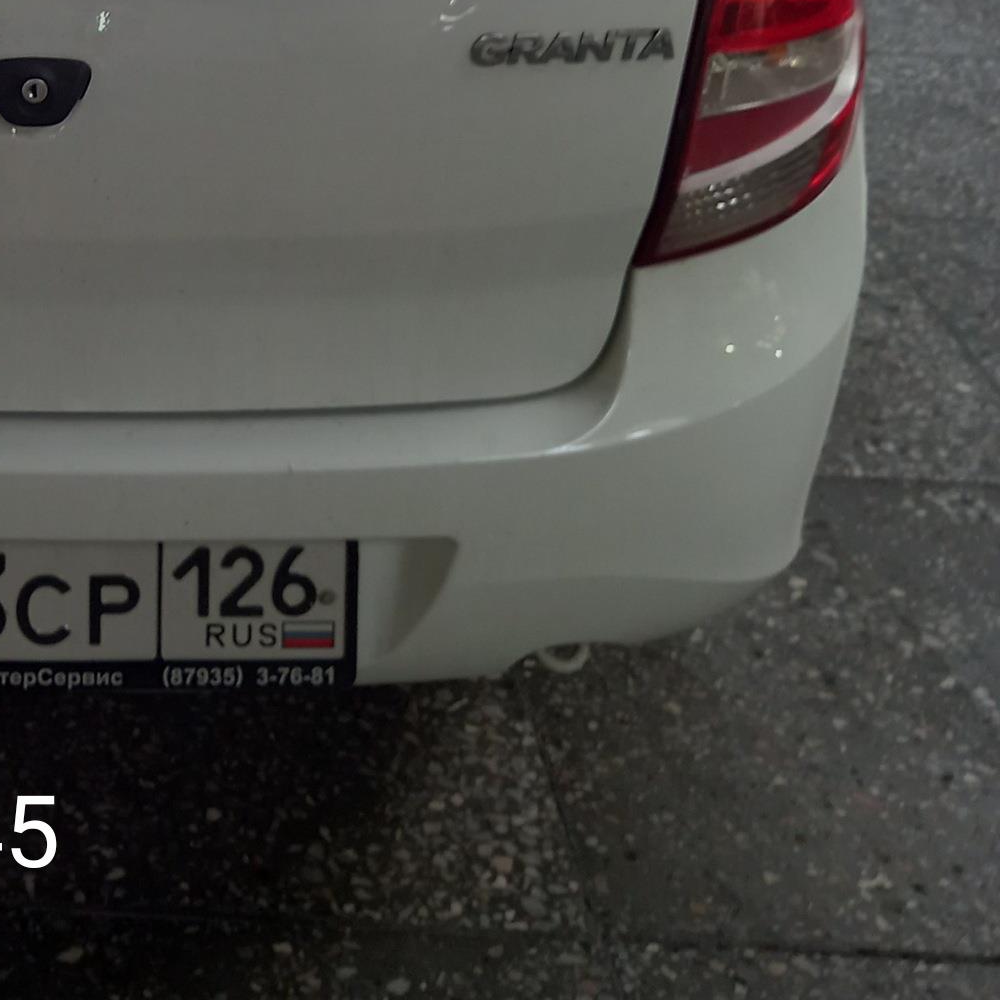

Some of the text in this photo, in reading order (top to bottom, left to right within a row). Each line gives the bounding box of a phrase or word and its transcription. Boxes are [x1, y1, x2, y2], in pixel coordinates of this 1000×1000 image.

[469, 26, 676, 67] GRANTA
[172, 546, 317, 618] 126
[204, 622, 279, 649] RUS
[162, 665, 244, 688] (87935)
[256, 666, 336, 686] 3-76-81
